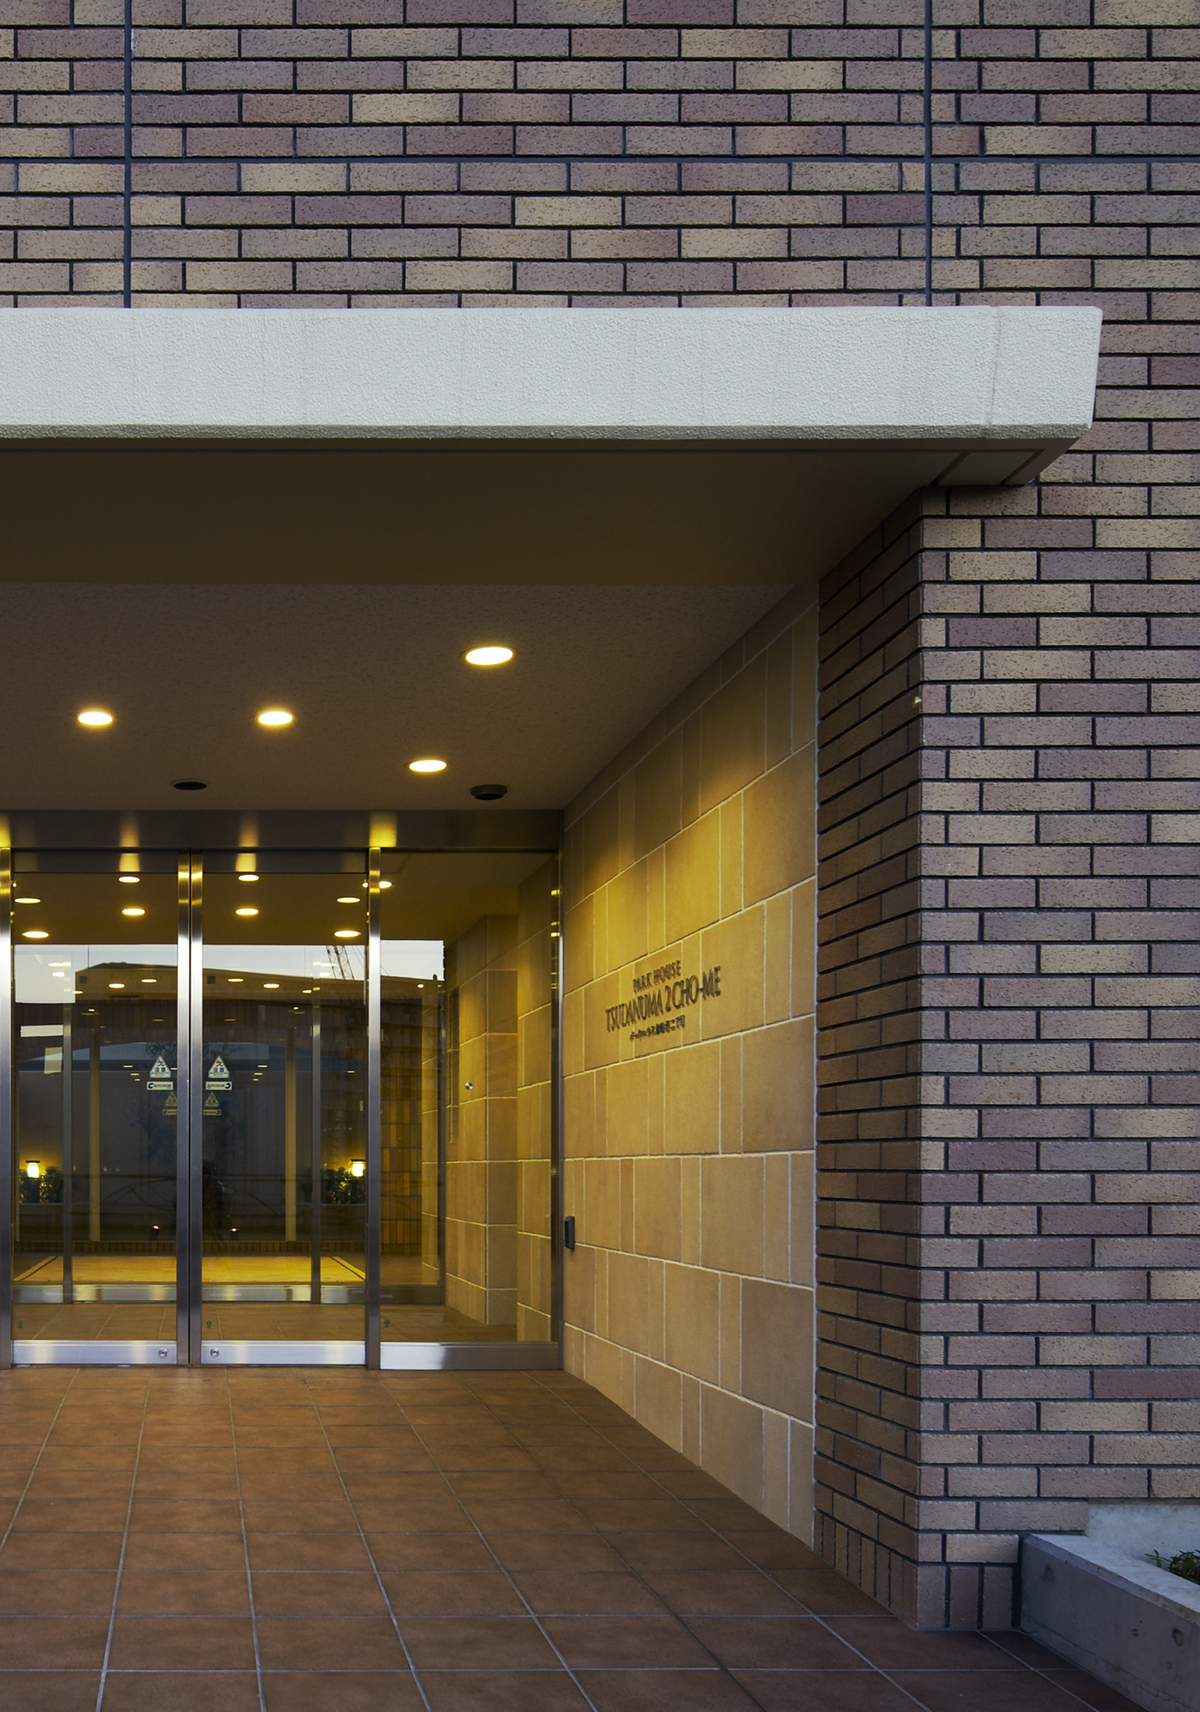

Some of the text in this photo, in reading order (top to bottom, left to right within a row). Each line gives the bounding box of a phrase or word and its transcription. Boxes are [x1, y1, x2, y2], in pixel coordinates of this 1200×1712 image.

[633, 960, 681, 993] PARK HOUSE
[605, 989, 664, 1032] TSUDANUMA
